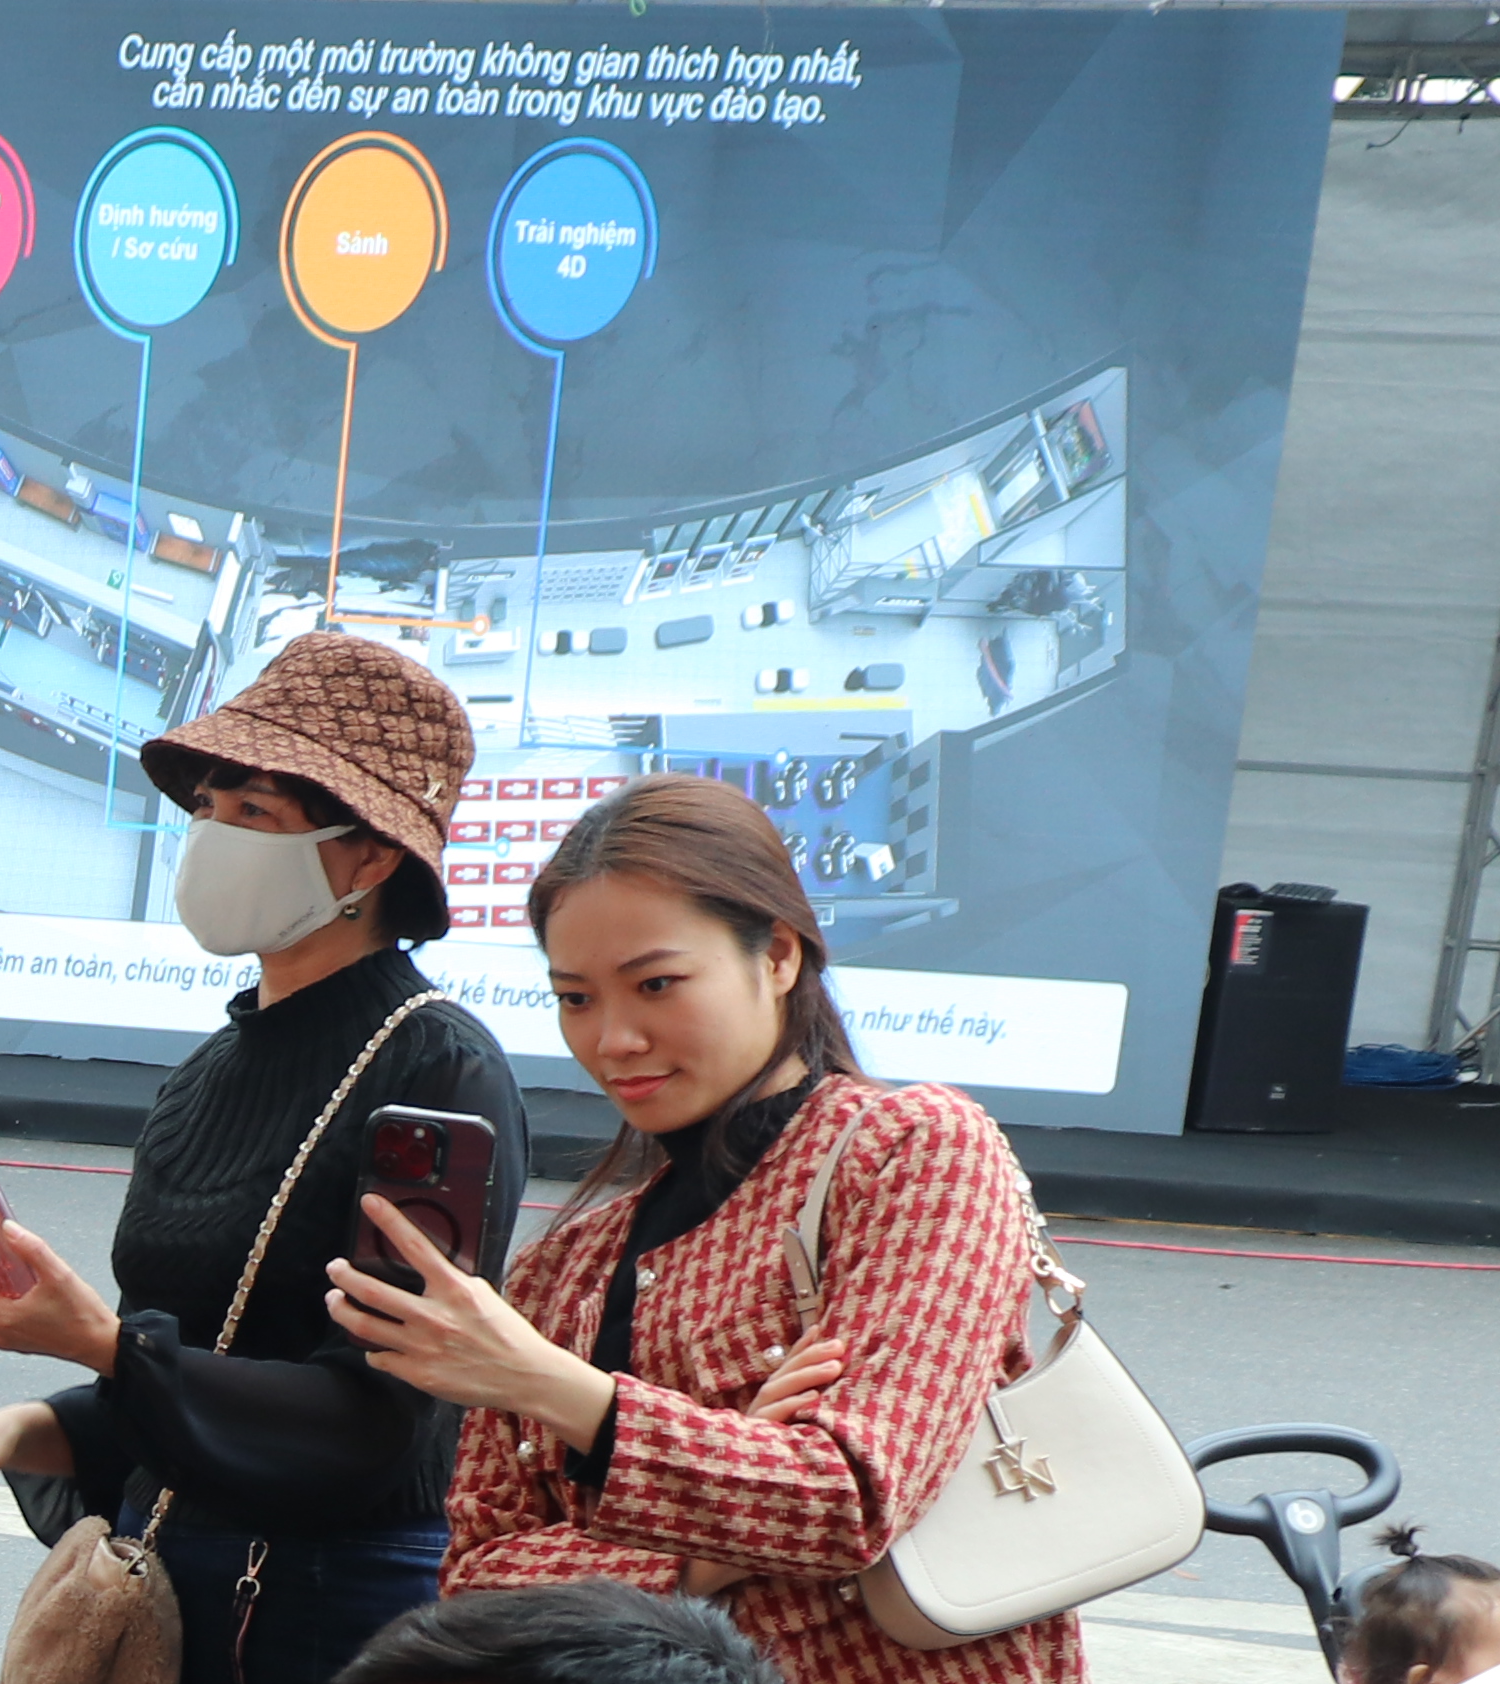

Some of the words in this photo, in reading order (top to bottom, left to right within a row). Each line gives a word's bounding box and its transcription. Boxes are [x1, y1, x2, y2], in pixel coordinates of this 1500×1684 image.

[119, 33, 195, 76] Cung
[200, 29, 251, 78] cấp
[257, 37, 316, 78] một
[318, 39, 375, 74] môi
[378, 40, 475, 83] trường
[480, 42, 572, 85] không
[576, 43, 640, 86] gian
[645, 45, 719, 82] thích
[723, 46, 783, 89] hợp
[789, 40, 863, 89] nhất,
[210, 68, 282, 112] nhắc
[287, 71, 341, 113] đến
[347, 85, 387, 119] sự
[392, 84, 427, 115] an
[432, 81, 500, 117] toàn
[504, 82, 582, 126] trong
[586, 83, 643, 119] khu
[650, 91, 705, 126] vực
[708, 85, 765, 124] đào
[772, 89, 826, 129] tạo.
[98, 203, 144, 231] Định
[149, 205, 218, 234] hướng
[515, 218, 555, 245] Trải
[559, 219, 637, 252] nghiệm
[125, 237, 155, 260] Sơ
[157, 236, 198, 261] cứu
[557, 255, 587, 280] 4D
[30, 955, 57, 976] an
[64, 954, 117, 982] toàn,
[125, 957, 196, 991] chúng
[202, 963, 231, 988] tôi
[459, 973, 487, 1004] kế
[861, 1005, 914, 1032] như
[917, 1003, 957, 1035] thế
[958, 1011, 1007, 1045] này.
